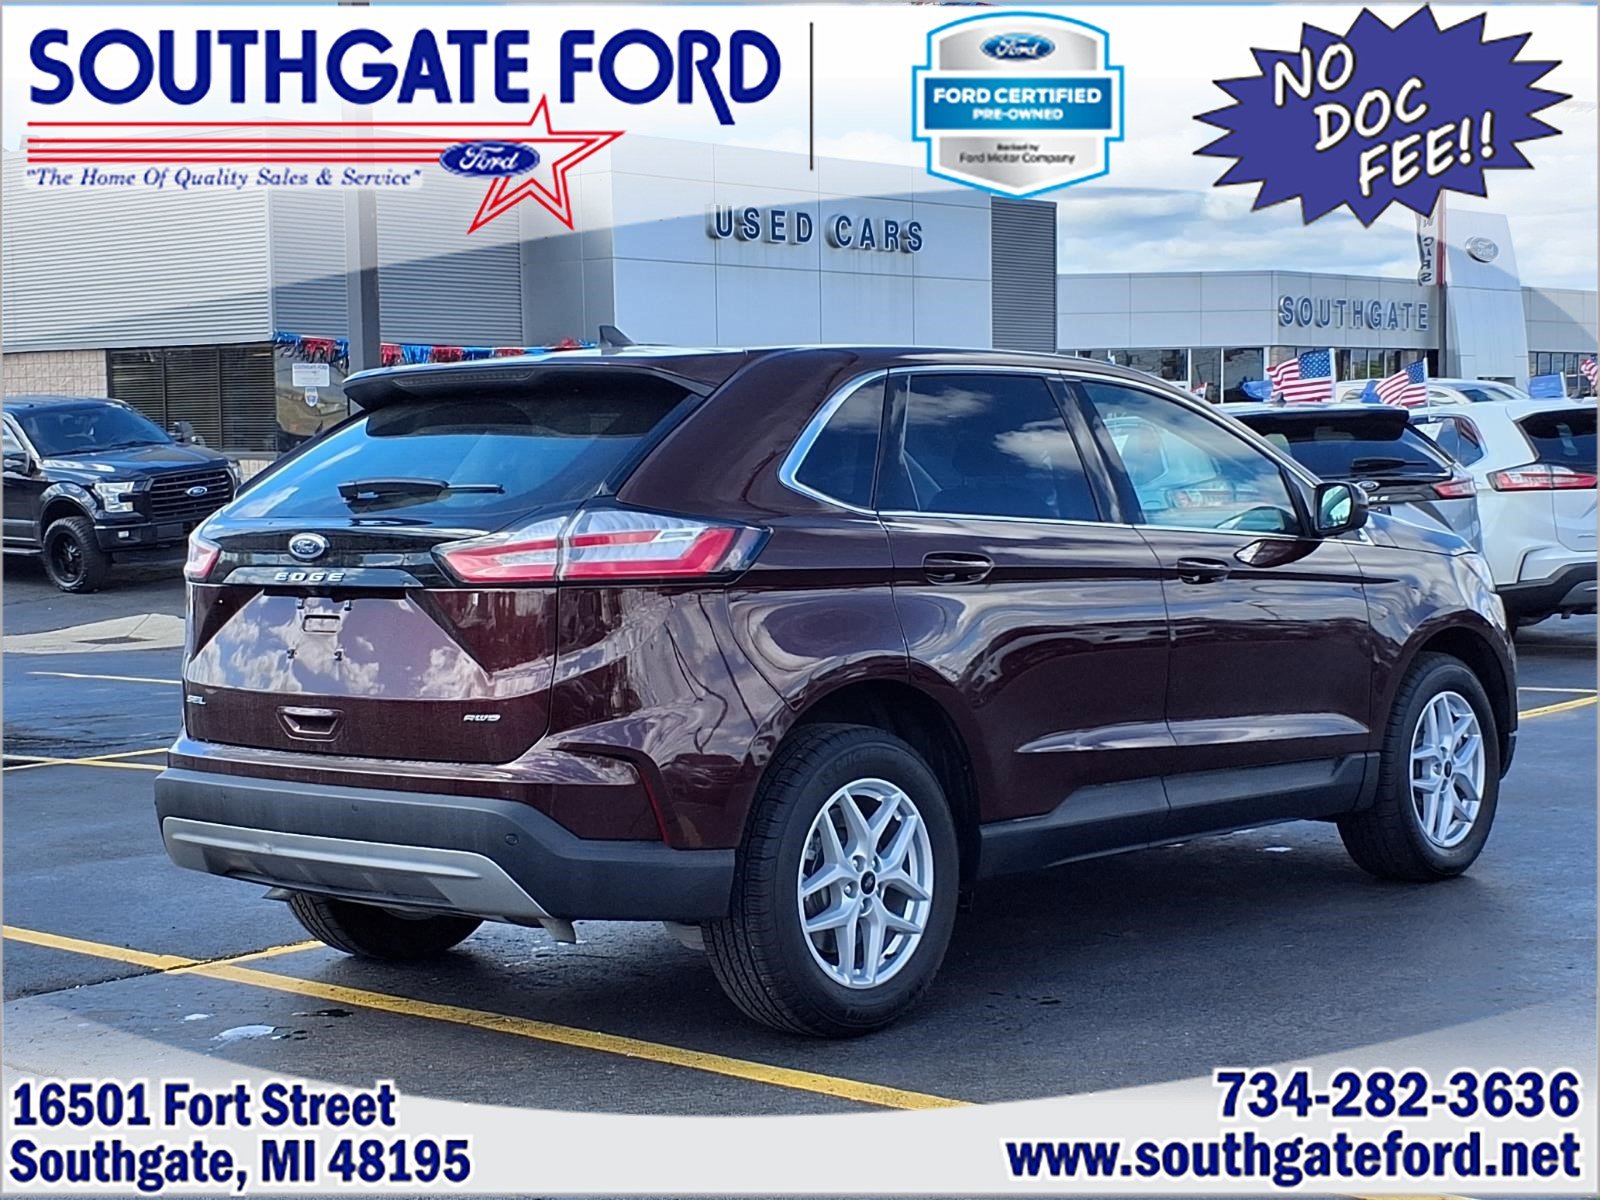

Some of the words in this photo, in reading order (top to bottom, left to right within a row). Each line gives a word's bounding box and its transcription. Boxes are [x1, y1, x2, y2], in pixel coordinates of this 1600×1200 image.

[707, 204, 814, 245] USED
[832, 214, 923, 253] CARS
[1280, 295, 1430, 331] SOUTHGATE
[274, 571, 346, 583] EDGE
[463, 713, 501, 722] AWD
